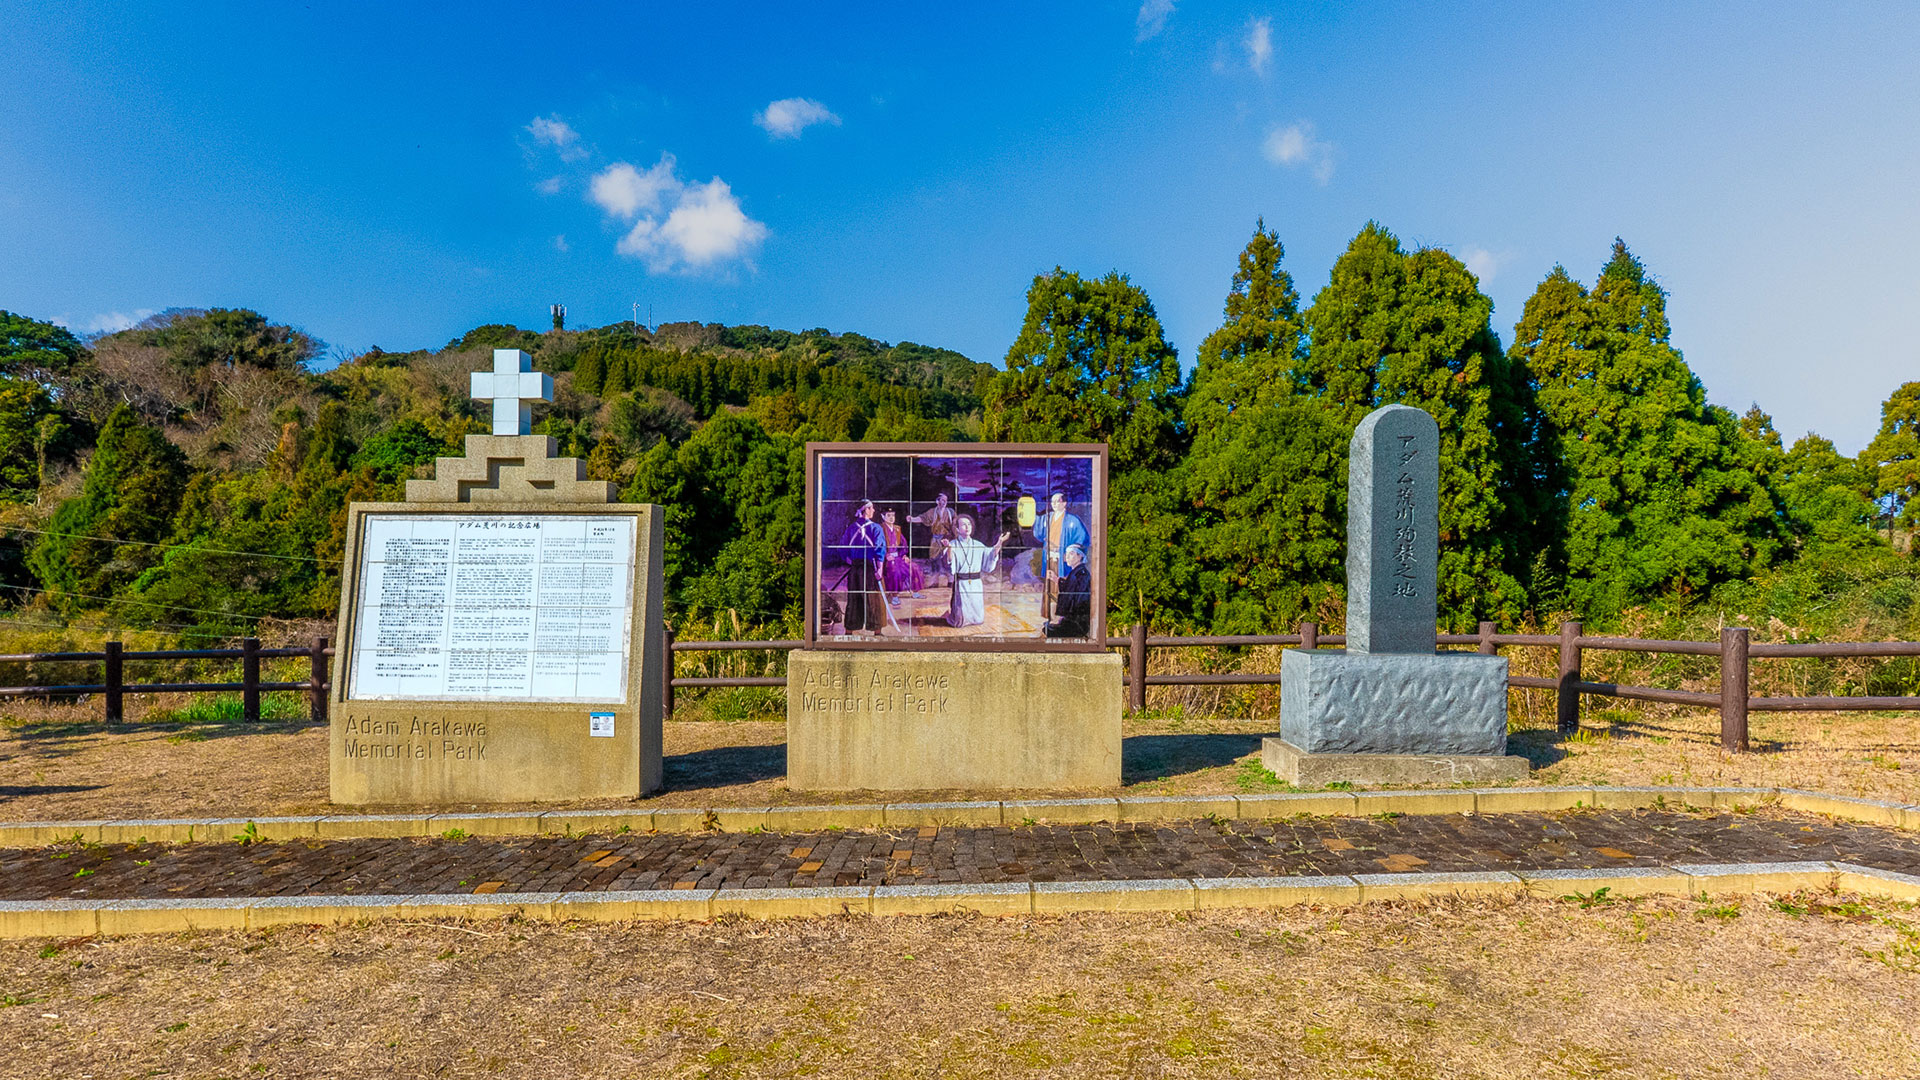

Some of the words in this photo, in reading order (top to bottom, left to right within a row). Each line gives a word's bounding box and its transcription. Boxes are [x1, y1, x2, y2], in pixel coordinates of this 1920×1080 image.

[1391, 434, 1418, 598] アダム荒川殉教之地
[803, 669, 859, 689] Adam
[870, 669, 949, 690] Arakawa
[802, 692, 893, 713] Memorial
[904, 692, 949, 713] Park
[345, 715, 399, 736] Adam
[410, 715, 487, 737] Arakawa
[344, 739, 432, 760] Memorial
[442, 739, 487, 760] Park
